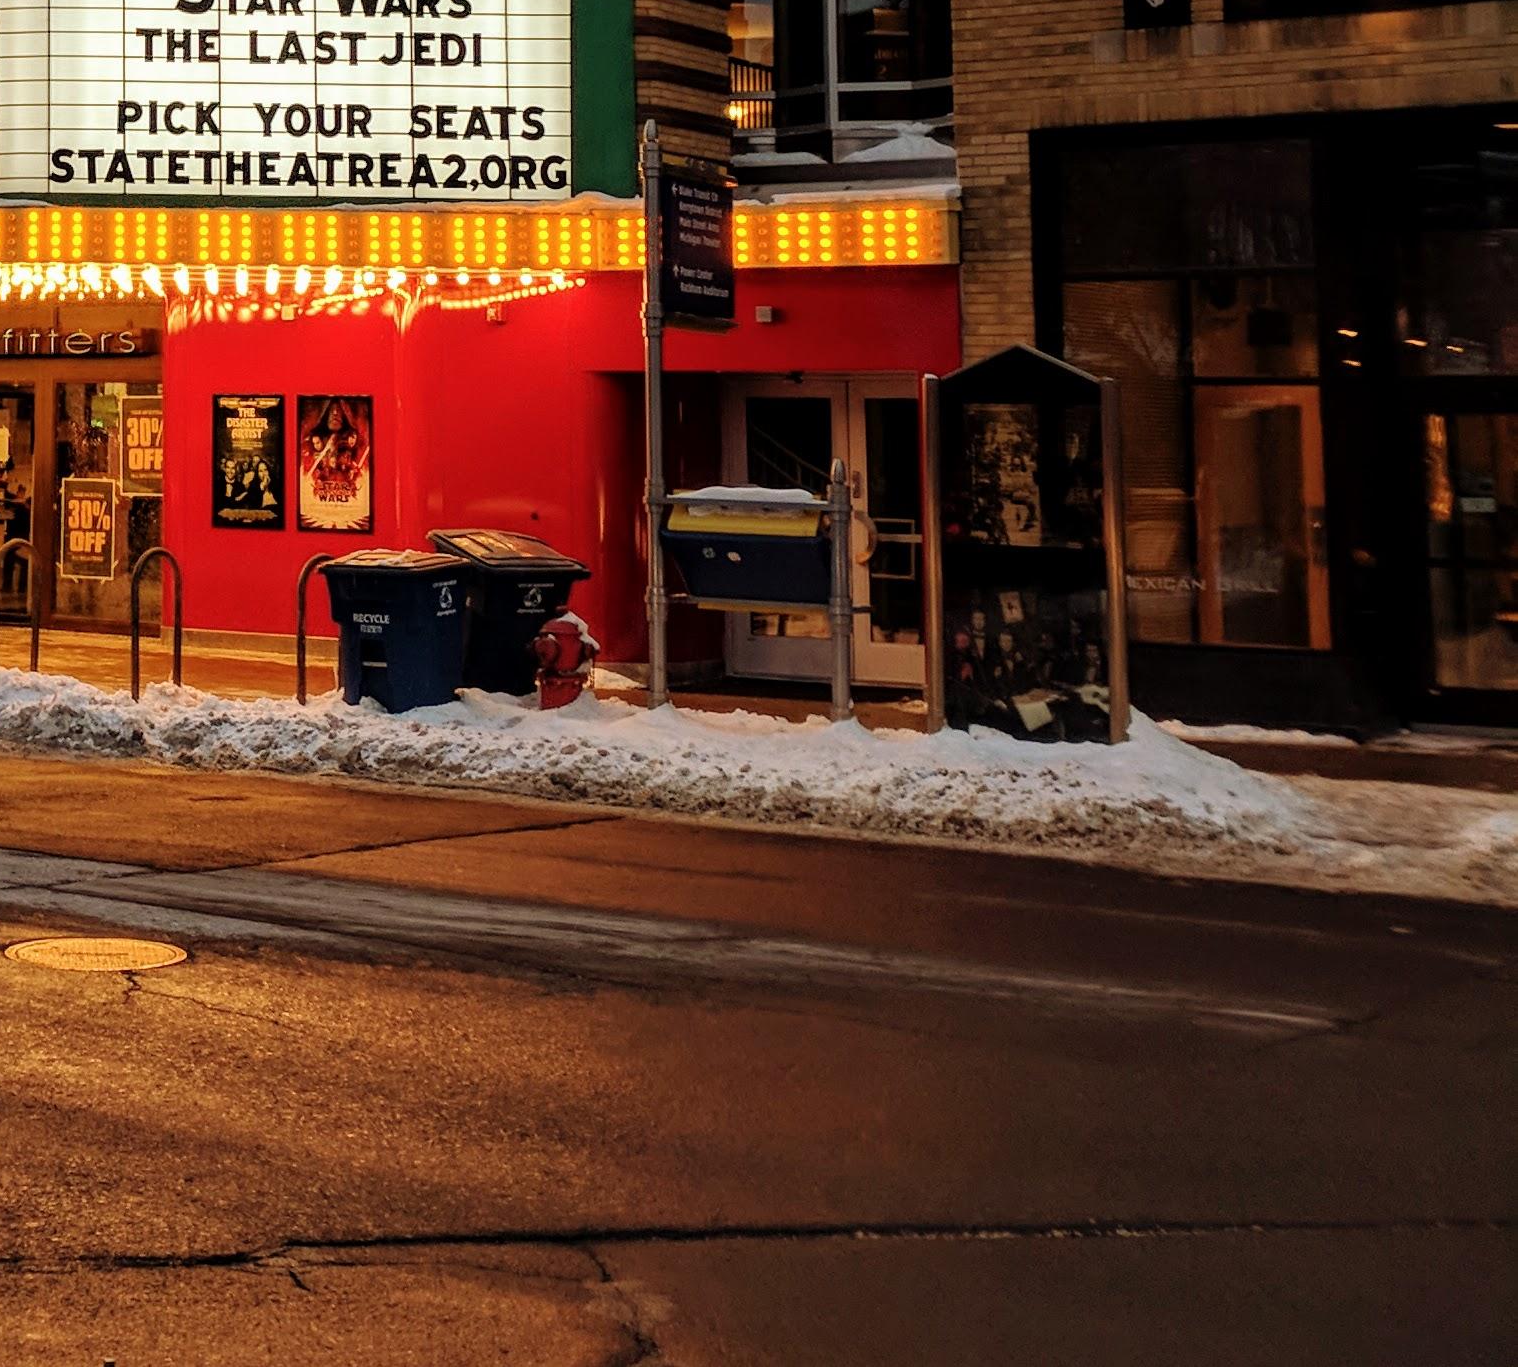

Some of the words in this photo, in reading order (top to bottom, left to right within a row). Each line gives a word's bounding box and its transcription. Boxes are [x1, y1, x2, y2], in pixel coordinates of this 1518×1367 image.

[136, 27, 221, 64] THE
[249, 30, 367, 67] LAST
[381, 32, 483, 68] JEDI
[117, 100, 221, 136] PICK
[254, 103, 373, 138] YOUR
[409, 104, 545, 141] SEATS
[68, 499, 111, 531] 30%
[69, 530, 106, 553] OFF
